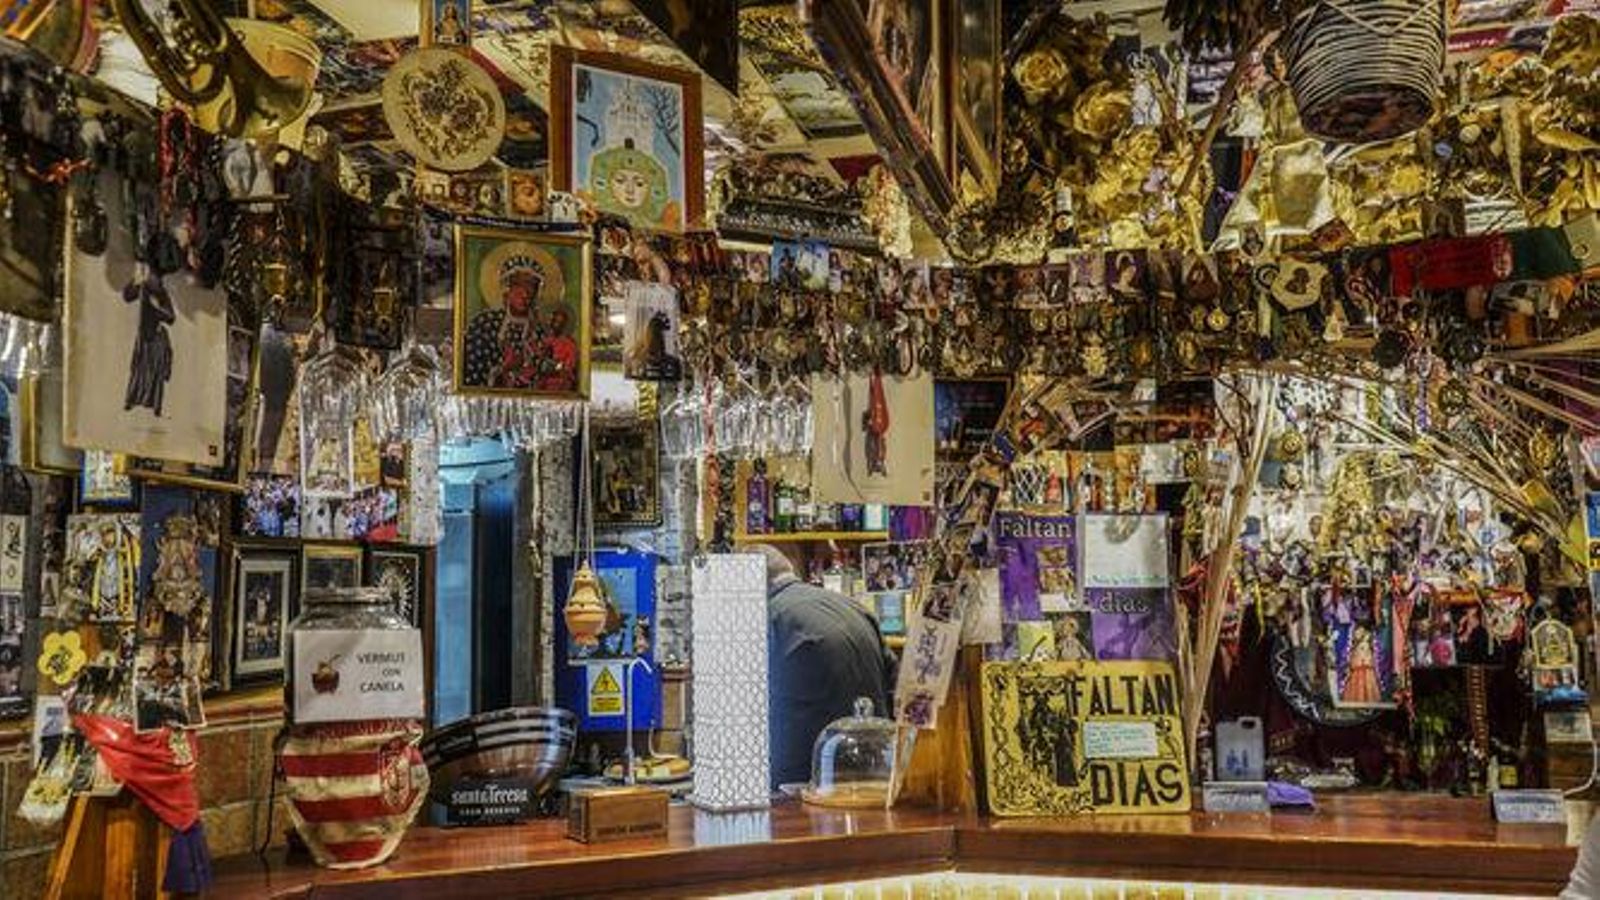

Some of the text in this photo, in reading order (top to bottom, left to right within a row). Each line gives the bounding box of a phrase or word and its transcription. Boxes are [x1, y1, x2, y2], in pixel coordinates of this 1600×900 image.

[999, 518, 1072, 538] Faltan
[356, 652, 405, 663] VERMUT
[361, 682, 404, 692] CANELA
[1070, 674, 1176, 716] FALTAN
[1090, 762, 1184, 806] DIAS
